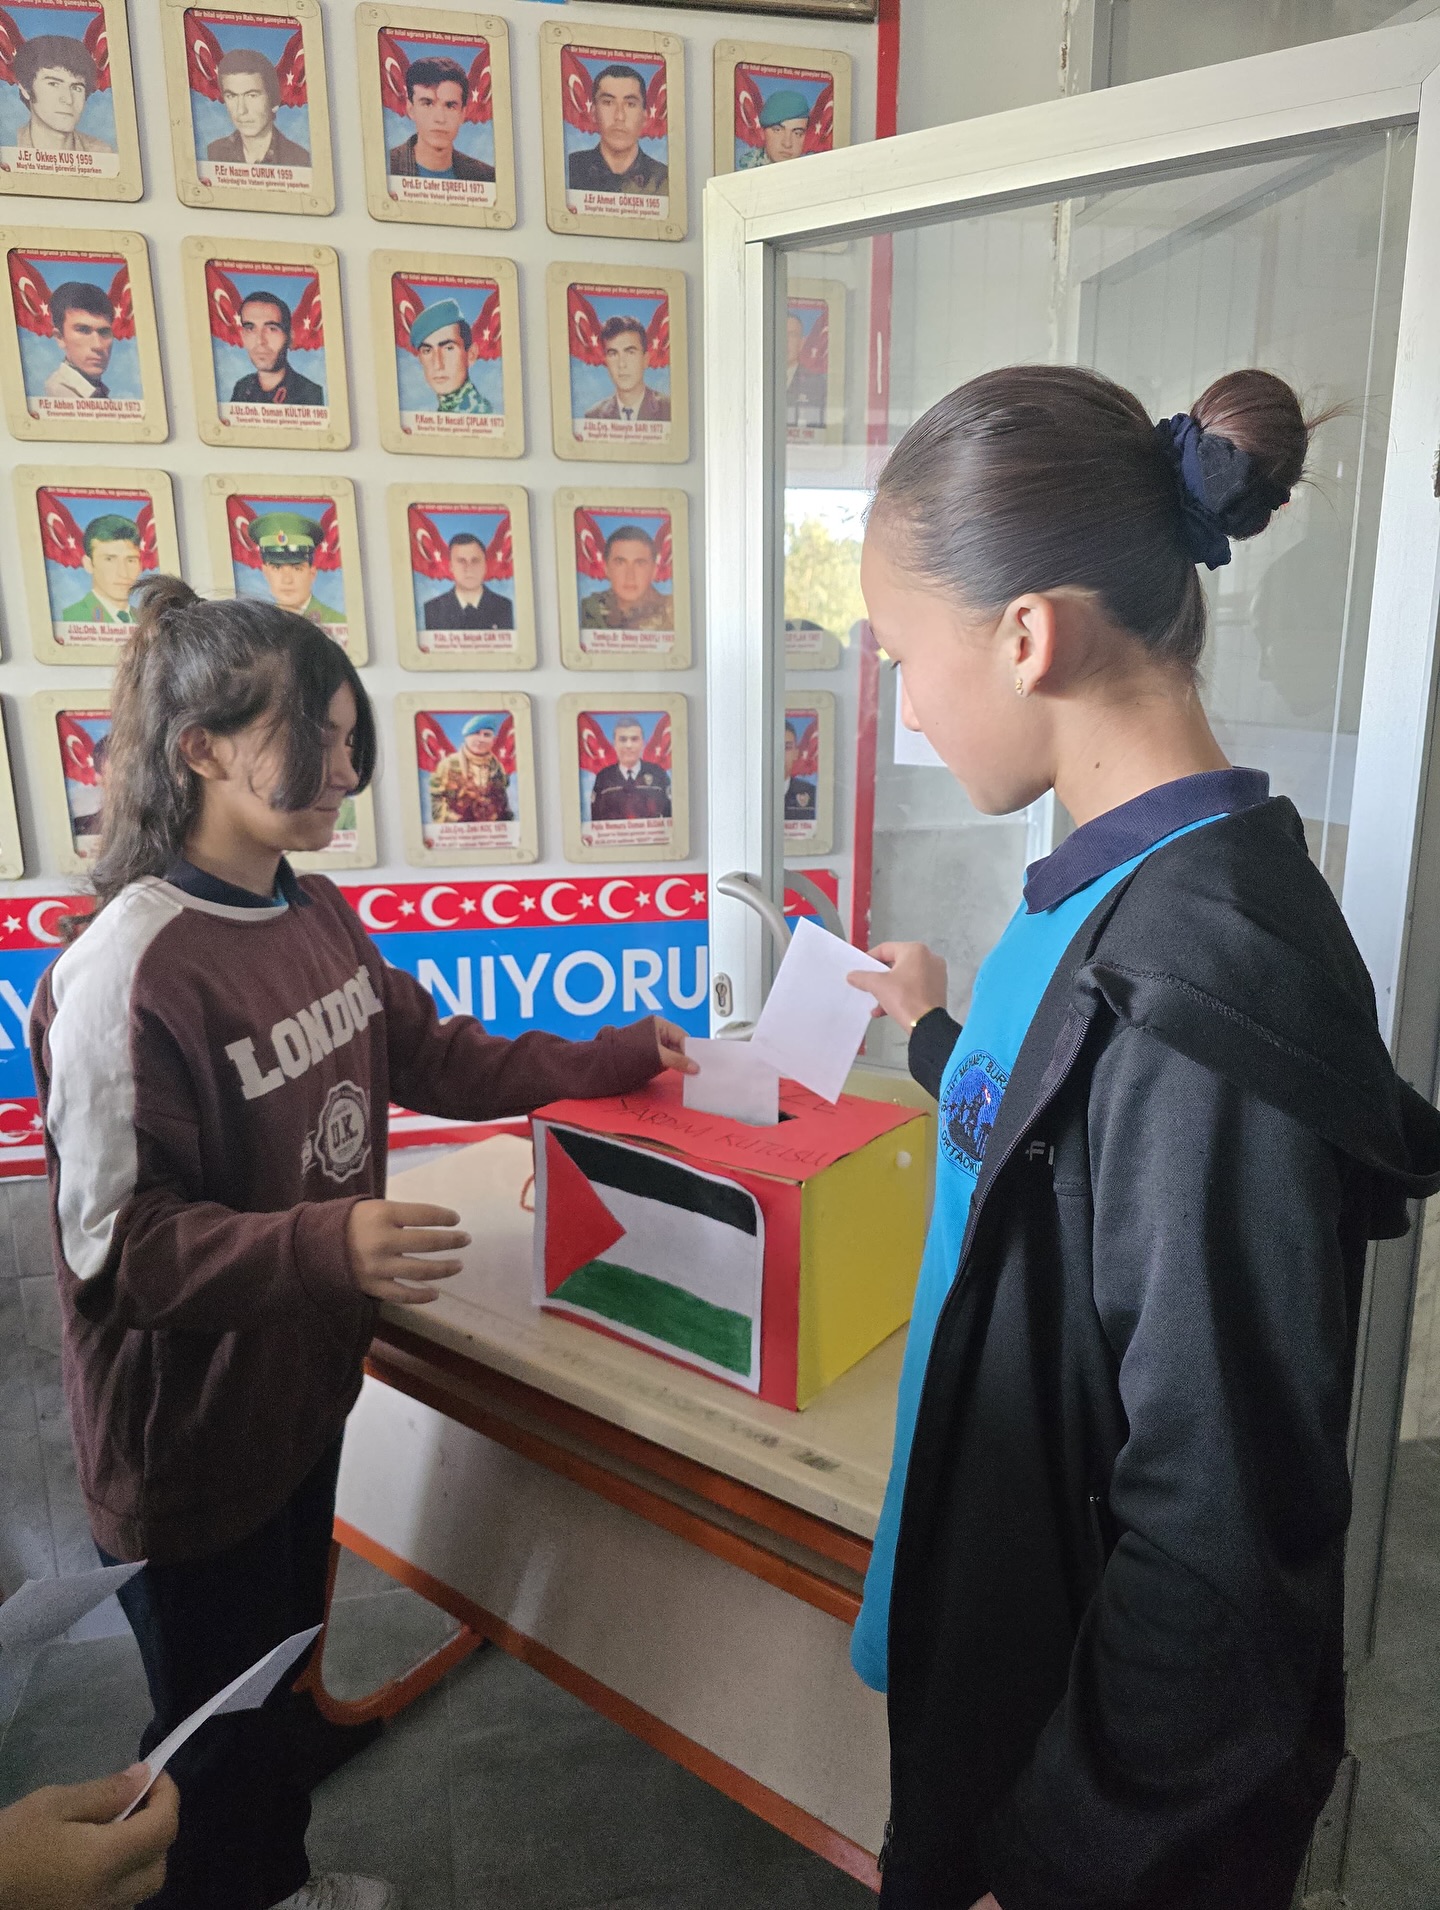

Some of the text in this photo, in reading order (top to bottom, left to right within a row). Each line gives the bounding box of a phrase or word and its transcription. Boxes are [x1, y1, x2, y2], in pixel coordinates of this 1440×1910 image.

[18, 149, 93, 165] J.Er Ökkeş KUŞ 1959
[55, 164, 76, 173] görevini
[77, 166, 102, 174] yaparken
[214, 165, 228, 175] P.Er
[277, 169, 293, 180] 1959
[423, 180, 440, 190] Cafer
[469, 183, 484, 194] 1973
[384, 946, 708, 1020] NIYORU
[225, 965, 384, 1100] LONDON
